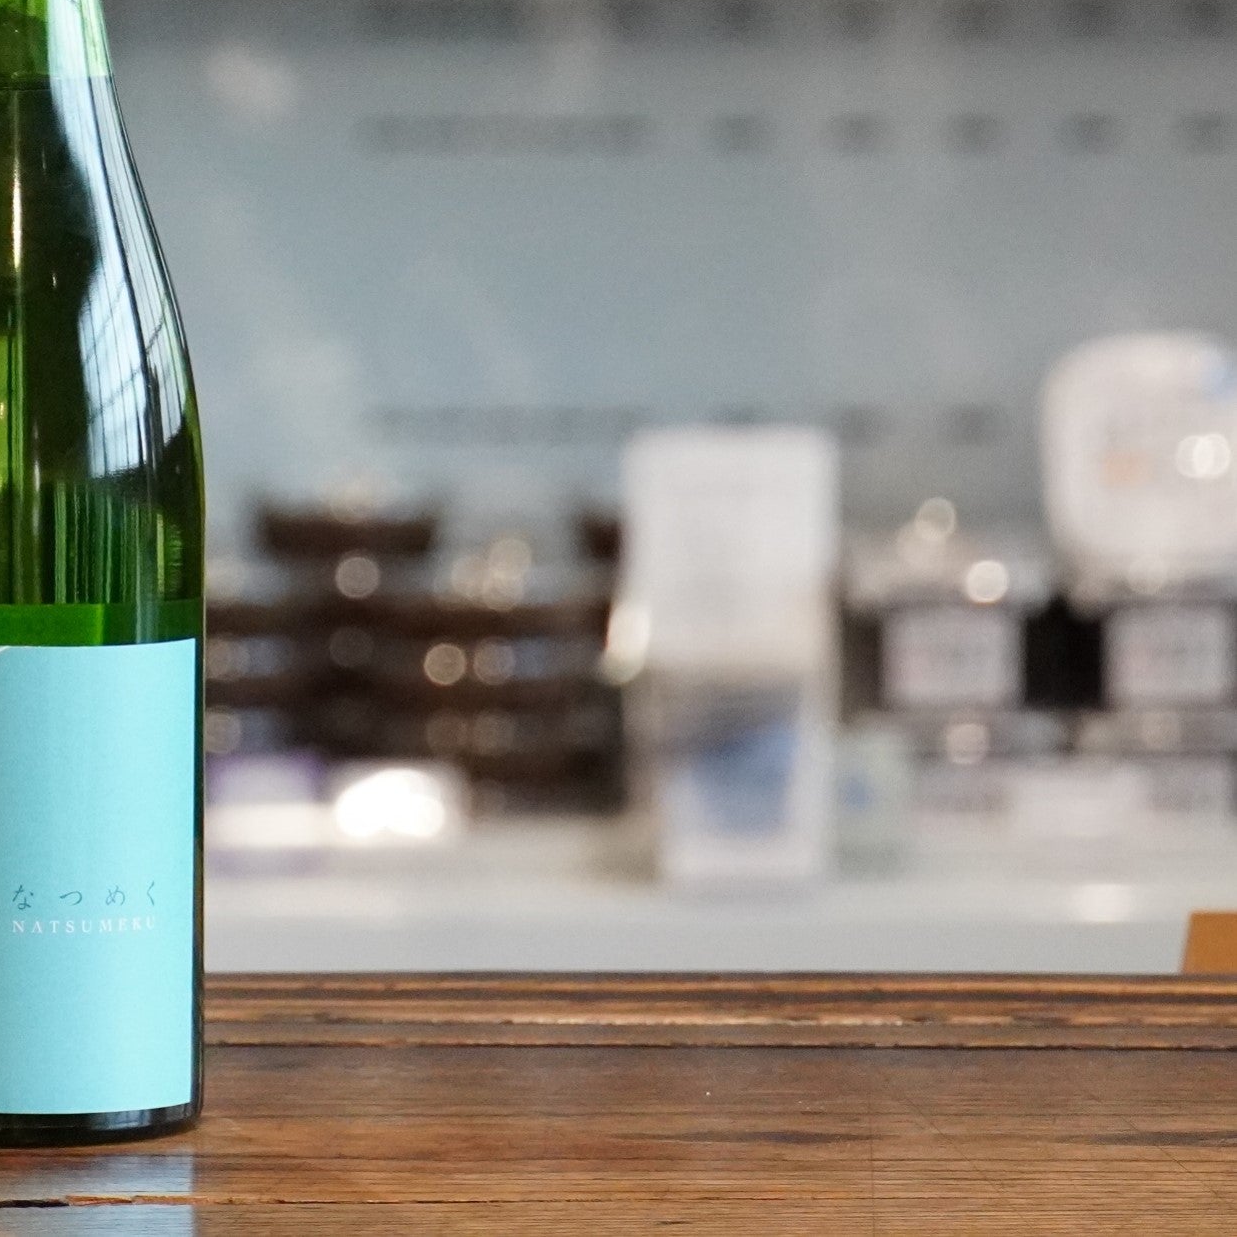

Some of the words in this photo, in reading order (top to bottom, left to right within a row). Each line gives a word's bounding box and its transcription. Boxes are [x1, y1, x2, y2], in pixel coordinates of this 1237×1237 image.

[12, 881, 155, 910] なつめく
[12, 916, 156, 934] NATSUMEKU
